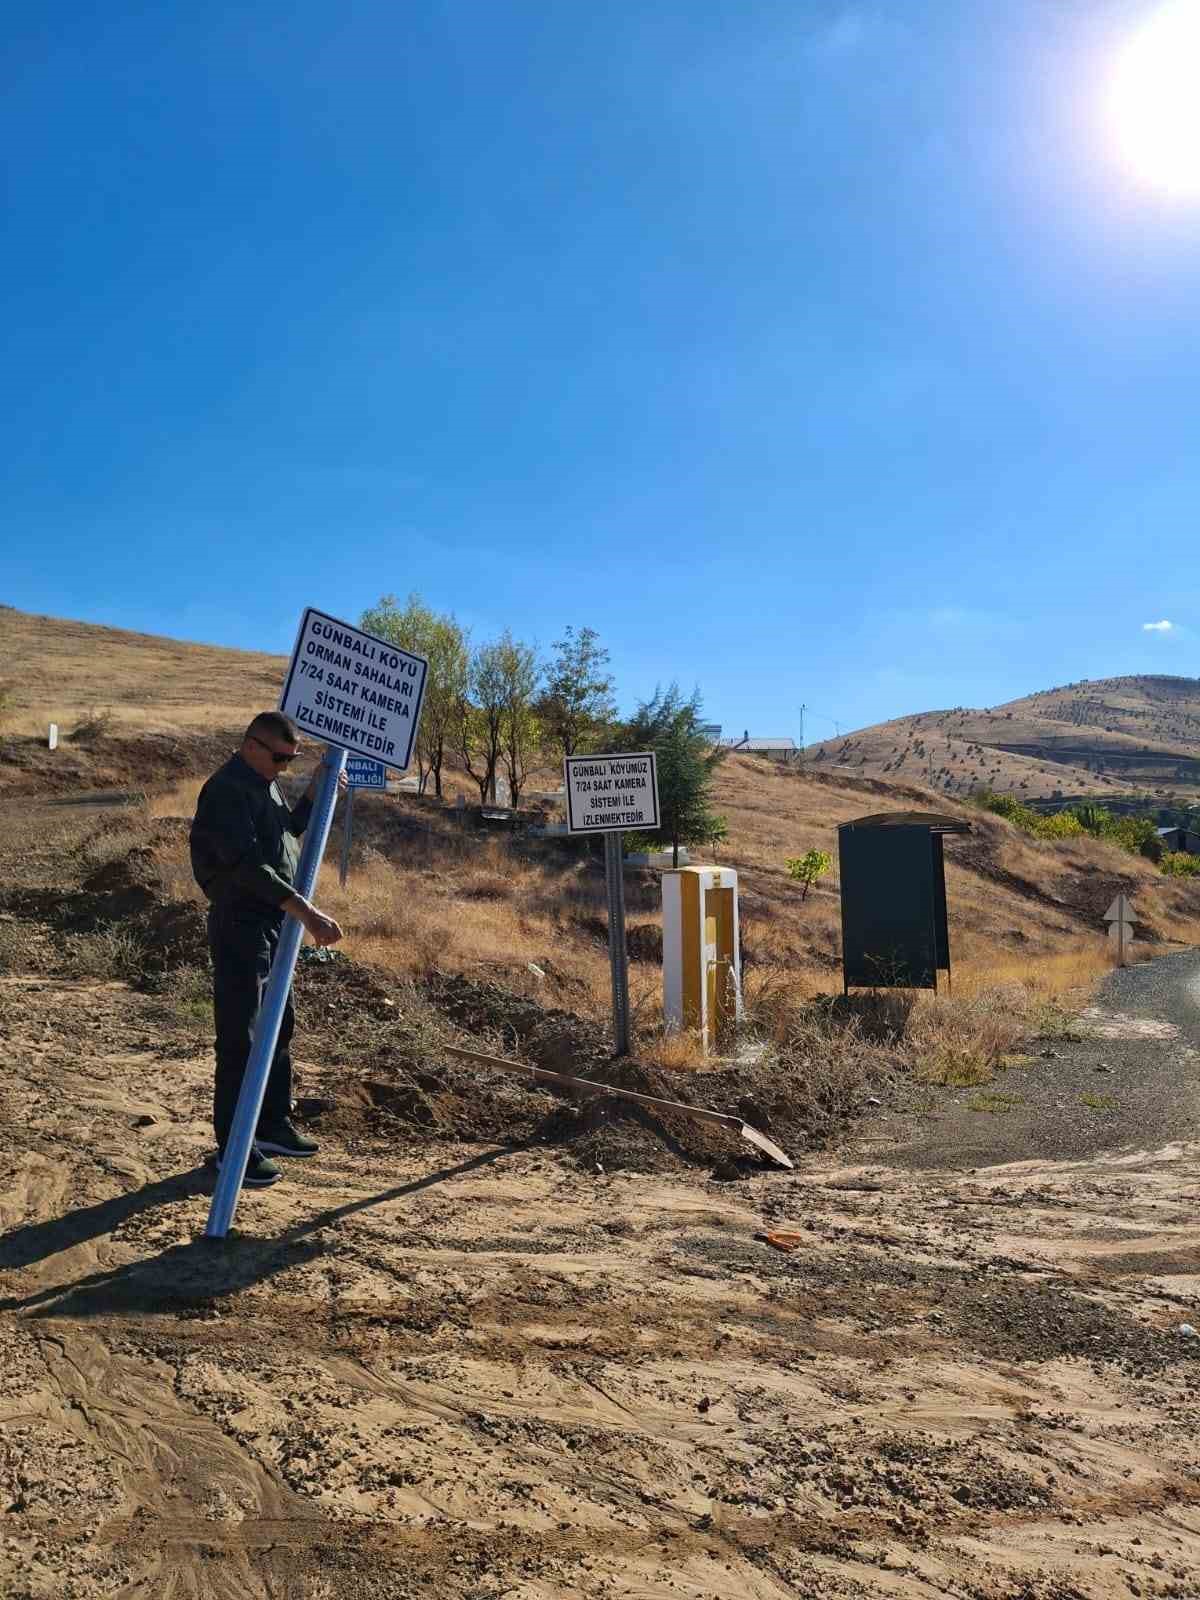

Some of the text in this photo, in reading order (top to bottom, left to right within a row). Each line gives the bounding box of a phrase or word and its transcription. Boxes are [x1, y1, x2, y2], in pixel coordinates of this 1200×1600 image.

[311, 621, 375, 660] GÜNBALI
[306, 641, 413, 697] ORMAN SAHALARI
[300, 660, 409, 718] 7/24 SAAT KAMERA
[295, 703, 395, 756] İZLENMEKTEDİR
[314, 690, 387, 731] SİSTEMİ İLE
[347, 760, 377, 771] NBALI
[348, 773, 382, 785] ARLIĞI
[593, 780, 611, 791] SAAT
[614, 777, 647, 790] KAMERA
[590, 795, 620, 808] SİSTEMİ
